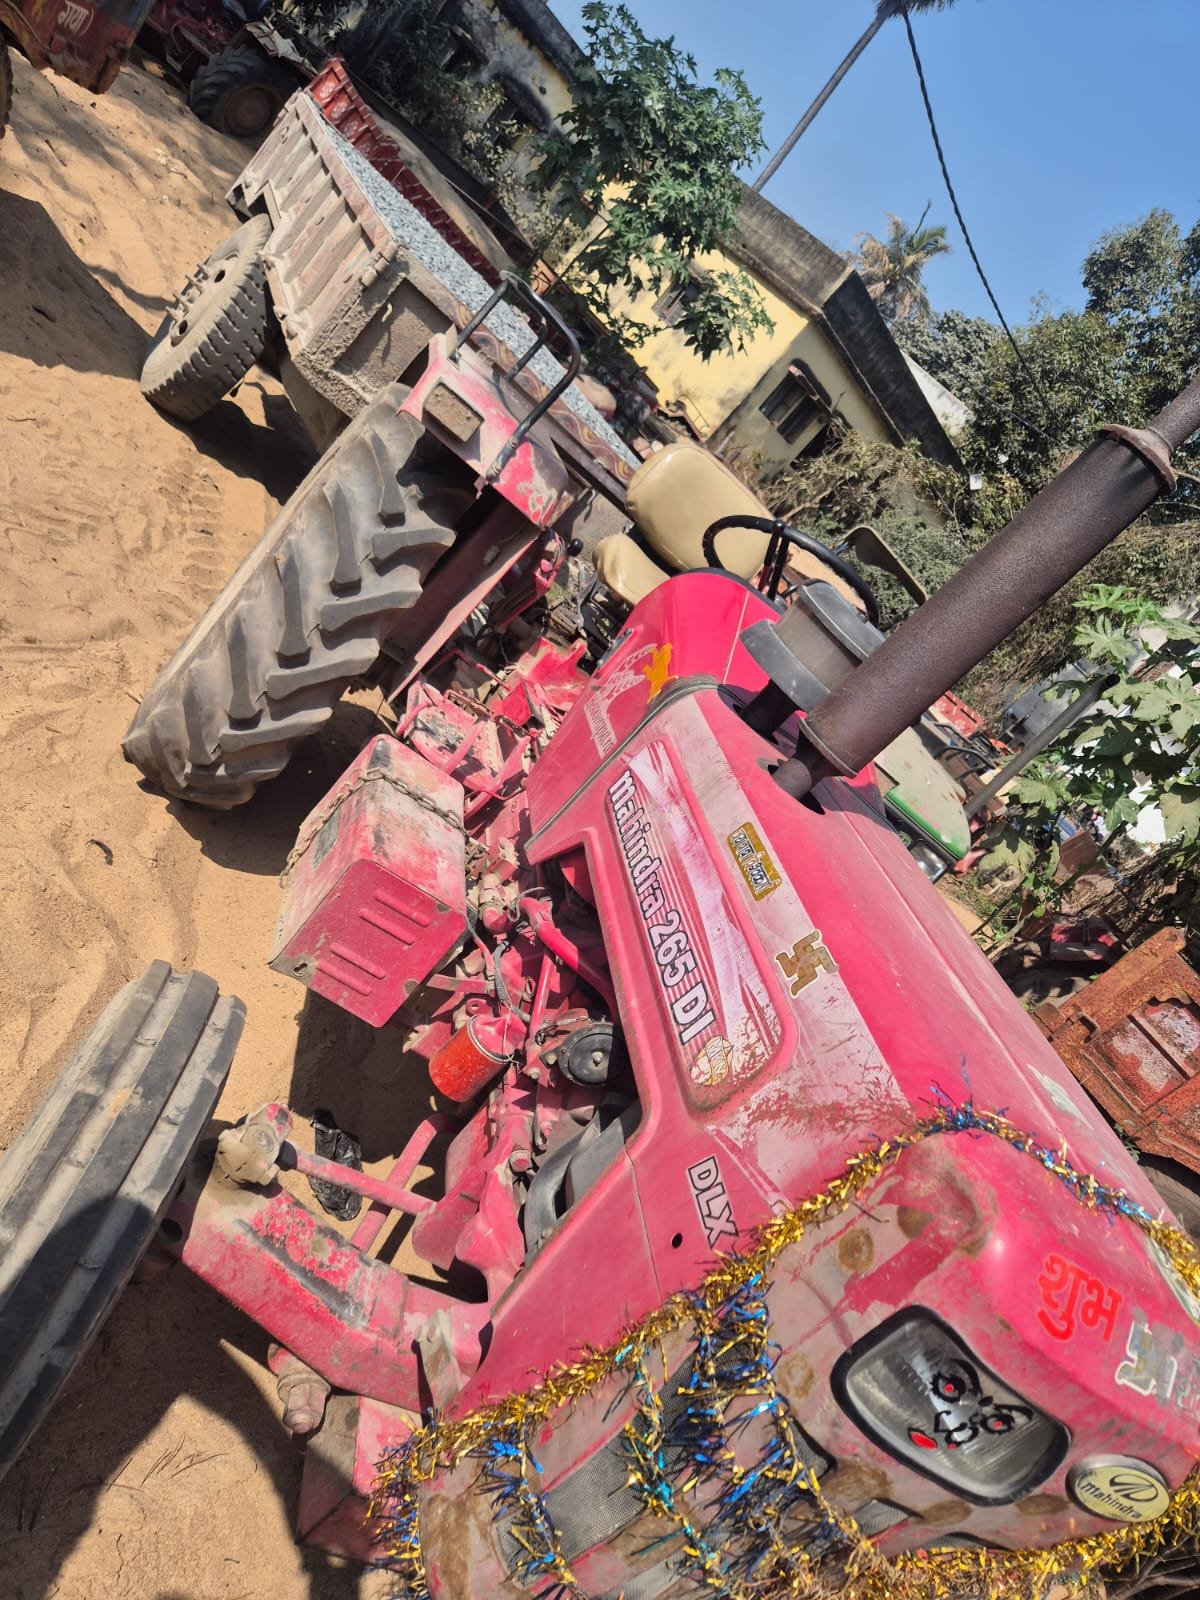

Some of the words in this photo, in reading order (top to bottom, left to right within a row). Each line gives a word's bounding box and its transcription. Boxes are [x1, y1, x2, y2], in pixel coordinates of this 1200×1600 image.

[608, 769, 665, 921] mahindra
[649, 909, 697, 989] 265
[671, 980, 716, 1046] DI
[688, 1156, 739, 1248] DLX
[1037, 1253, 1123, 1342] शुभ
[1080, 1482, 1143, 1519] mahindra
